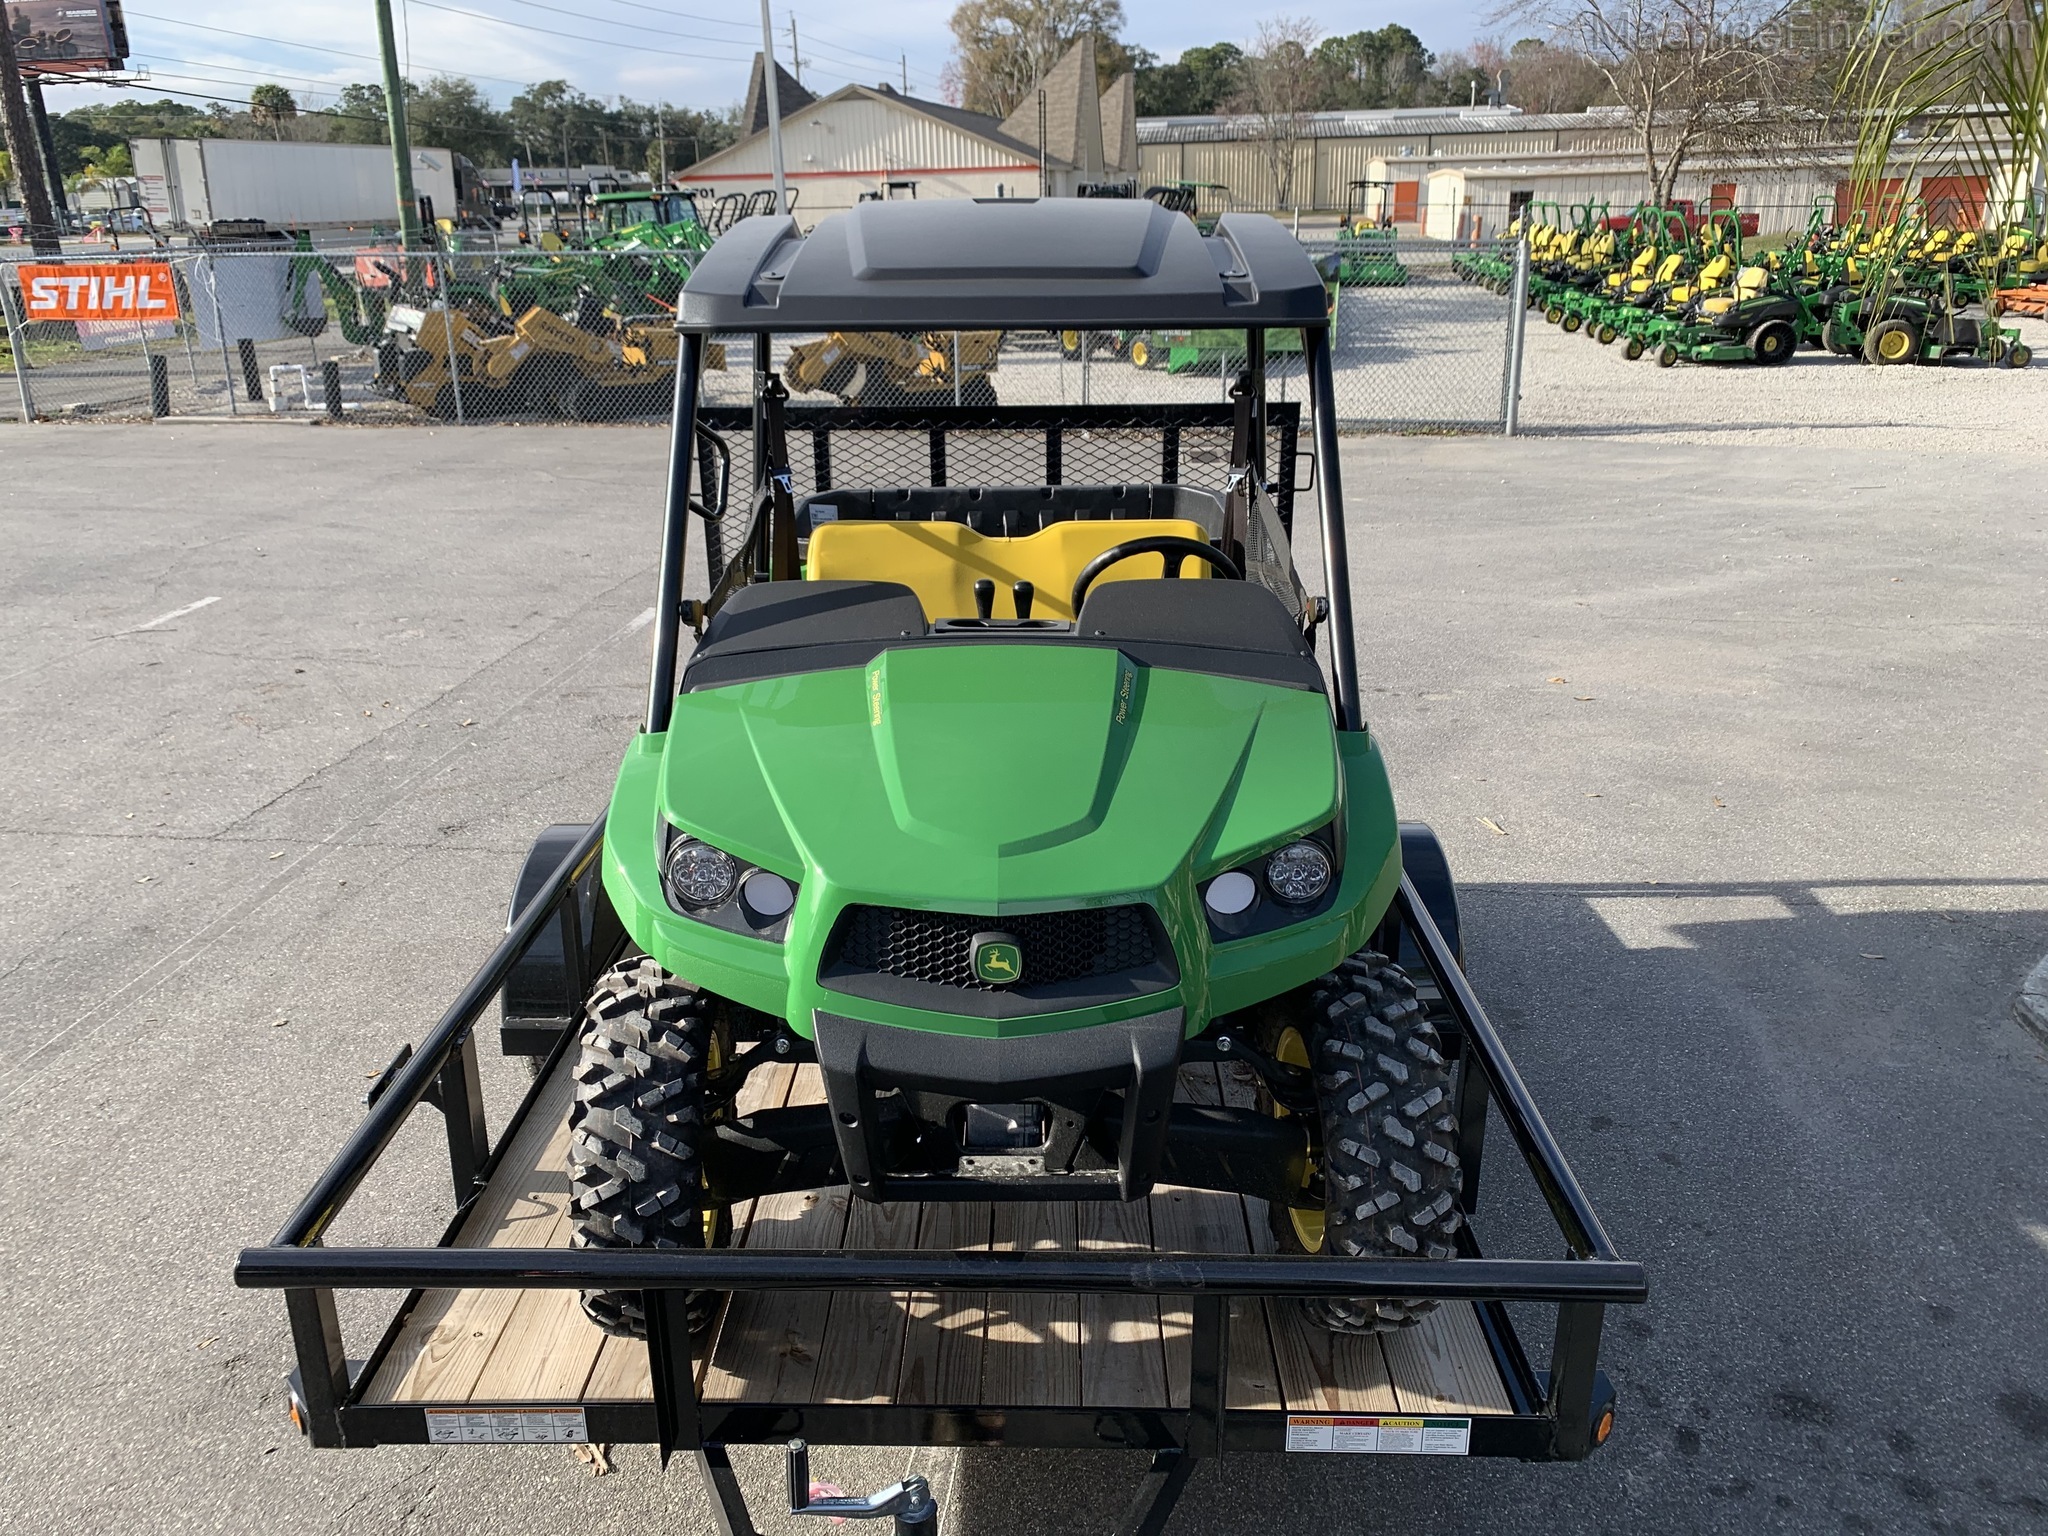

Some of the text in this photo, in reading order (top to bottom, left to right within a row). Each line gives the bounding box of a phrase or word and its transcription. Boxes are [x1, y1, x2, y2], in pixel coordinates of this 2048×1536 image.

[30, 275, 167, 310] STIHL
[872, 669, 881, 726] Power Steering
[1116, 669, 1133, 725] Power Steering
